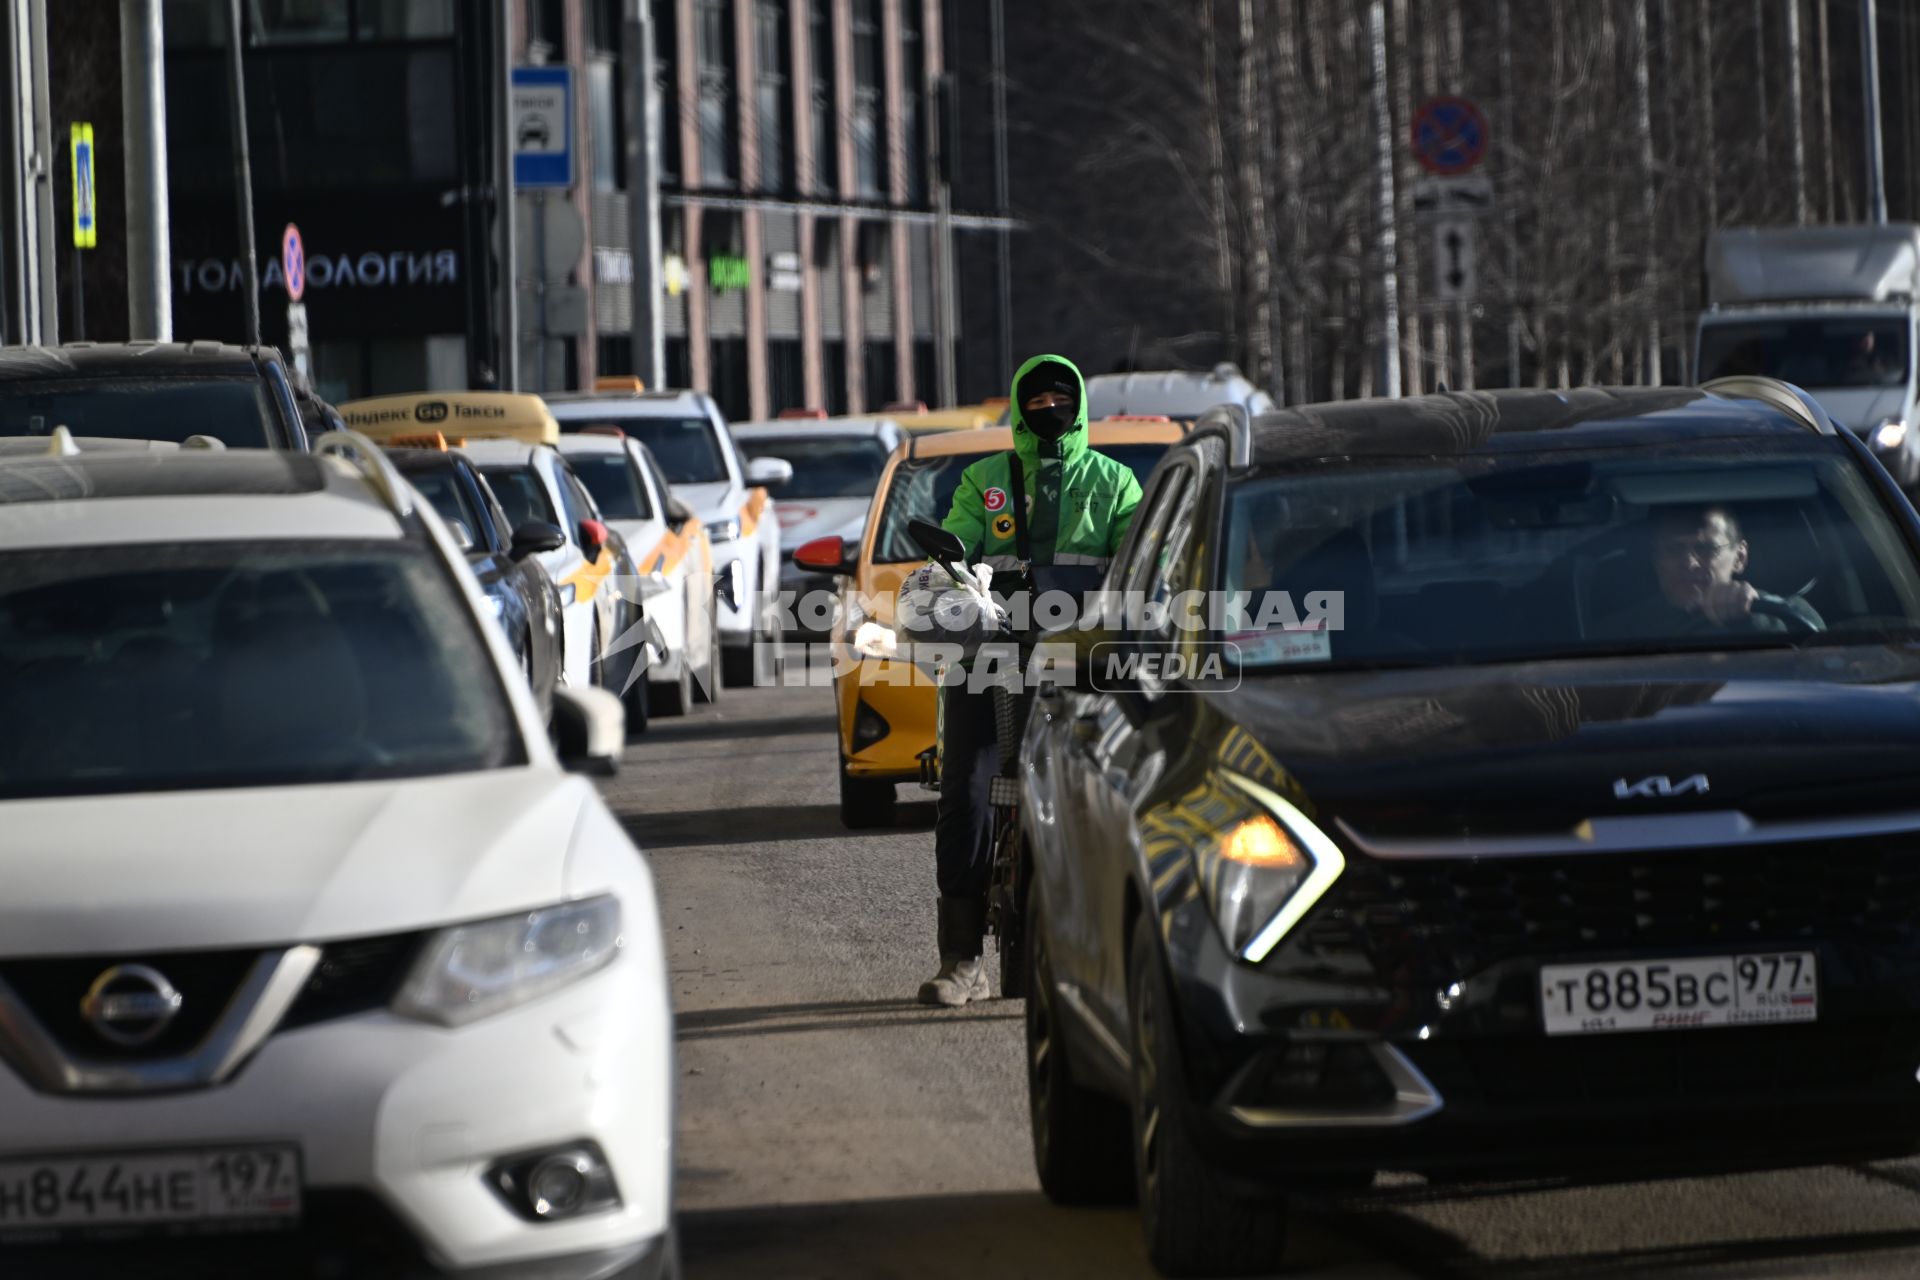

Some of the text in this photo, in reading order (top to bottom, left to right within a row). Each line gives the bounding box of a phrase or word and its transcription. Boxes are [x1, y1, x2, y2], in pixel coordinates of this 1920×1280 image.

[1556, 955, 1803, 1013] Т885ВС 977
[210, 1150, 283, 1194] 197
